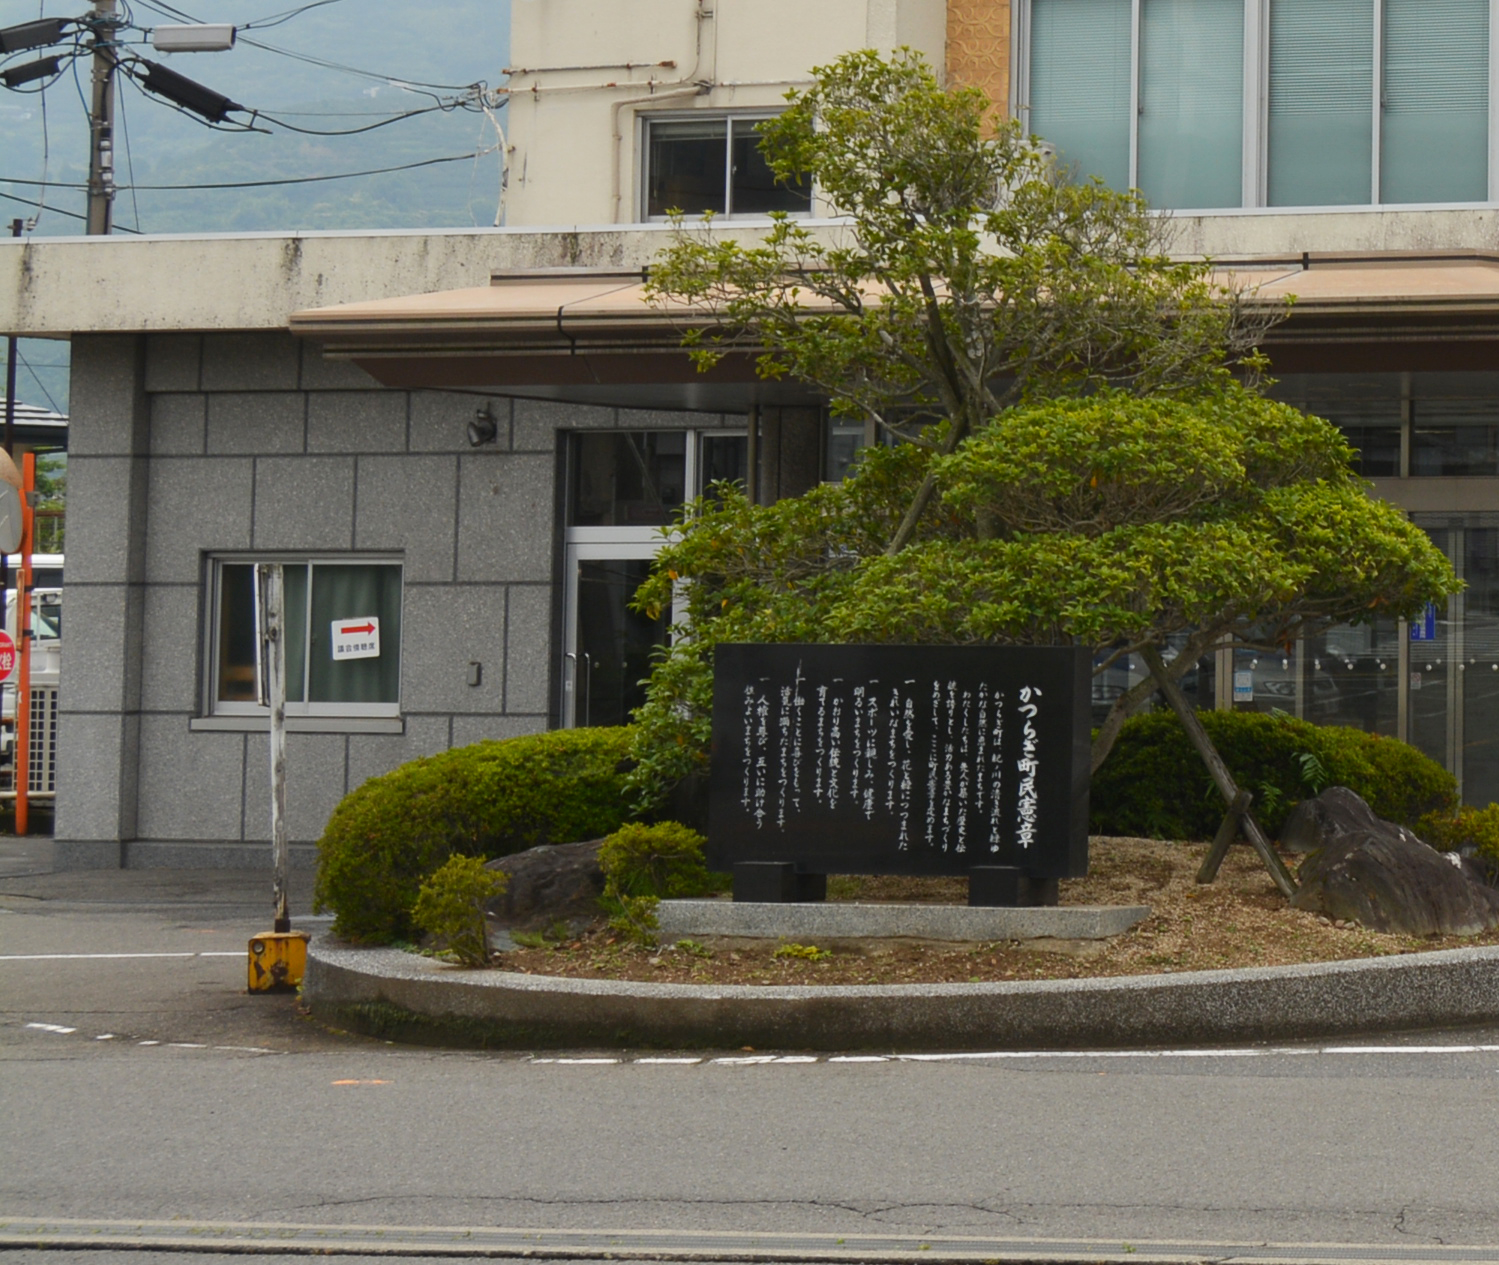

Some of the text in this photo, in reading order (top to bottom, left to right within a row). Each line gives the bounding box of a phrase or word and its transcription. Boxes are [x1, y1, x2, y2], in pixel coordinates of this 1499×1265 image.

[1016, 686, 1043, 849] かつらぎ町民憲章
